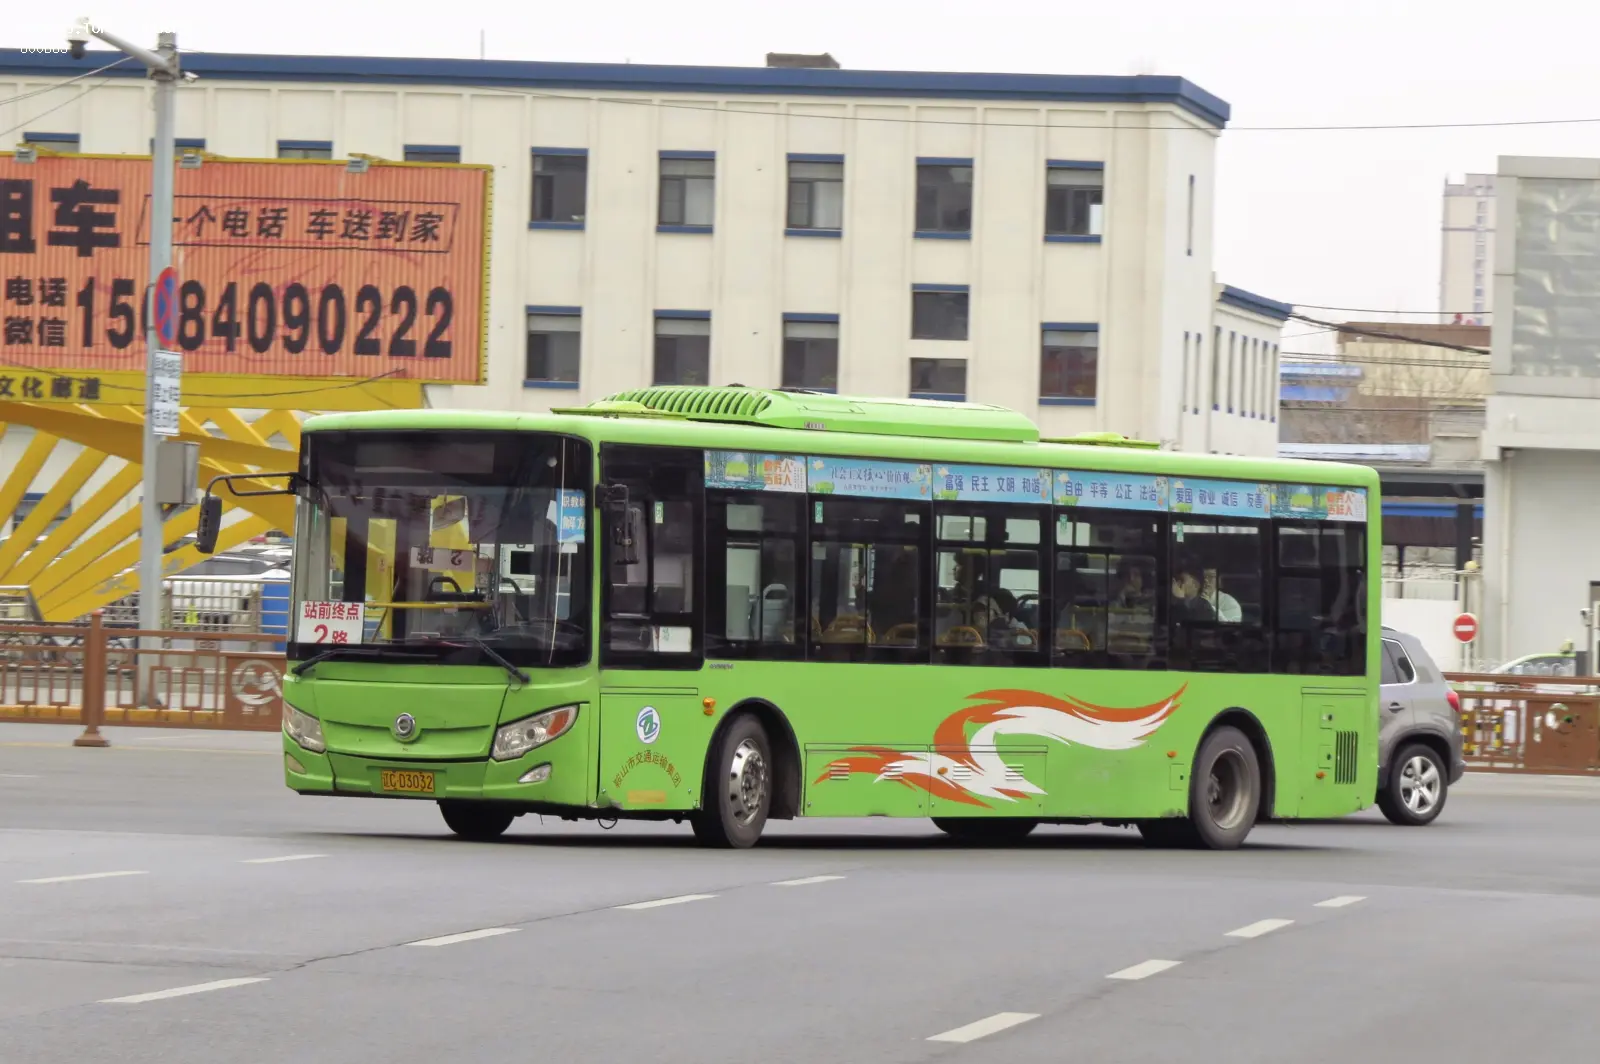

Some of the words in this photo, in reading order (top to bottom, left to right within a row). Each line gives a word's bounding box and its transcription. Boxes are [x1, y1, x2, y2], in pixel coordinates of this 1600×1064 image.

[306, 208, 444, 243] 车送到家
[6, 276, 68, 307] 电话
[4, 315, 67, 347] 微信
[77, 276, 453, 359] 1584090222
[945, 474, 964, 491] 富强
[971, 475, 989, 492] 民主
[996, 477, 1015, 493] 文明
[1022, 477, 1040, 494] 和谐
[1065, 481, 1083, 497] 自由
[1090, 482, 1109, 499] 平等
[1115, 483, 1133, 500] 公正
[1140, 484, 1157, 502] 法治
[304, 600, 360, 620] 站前终点
